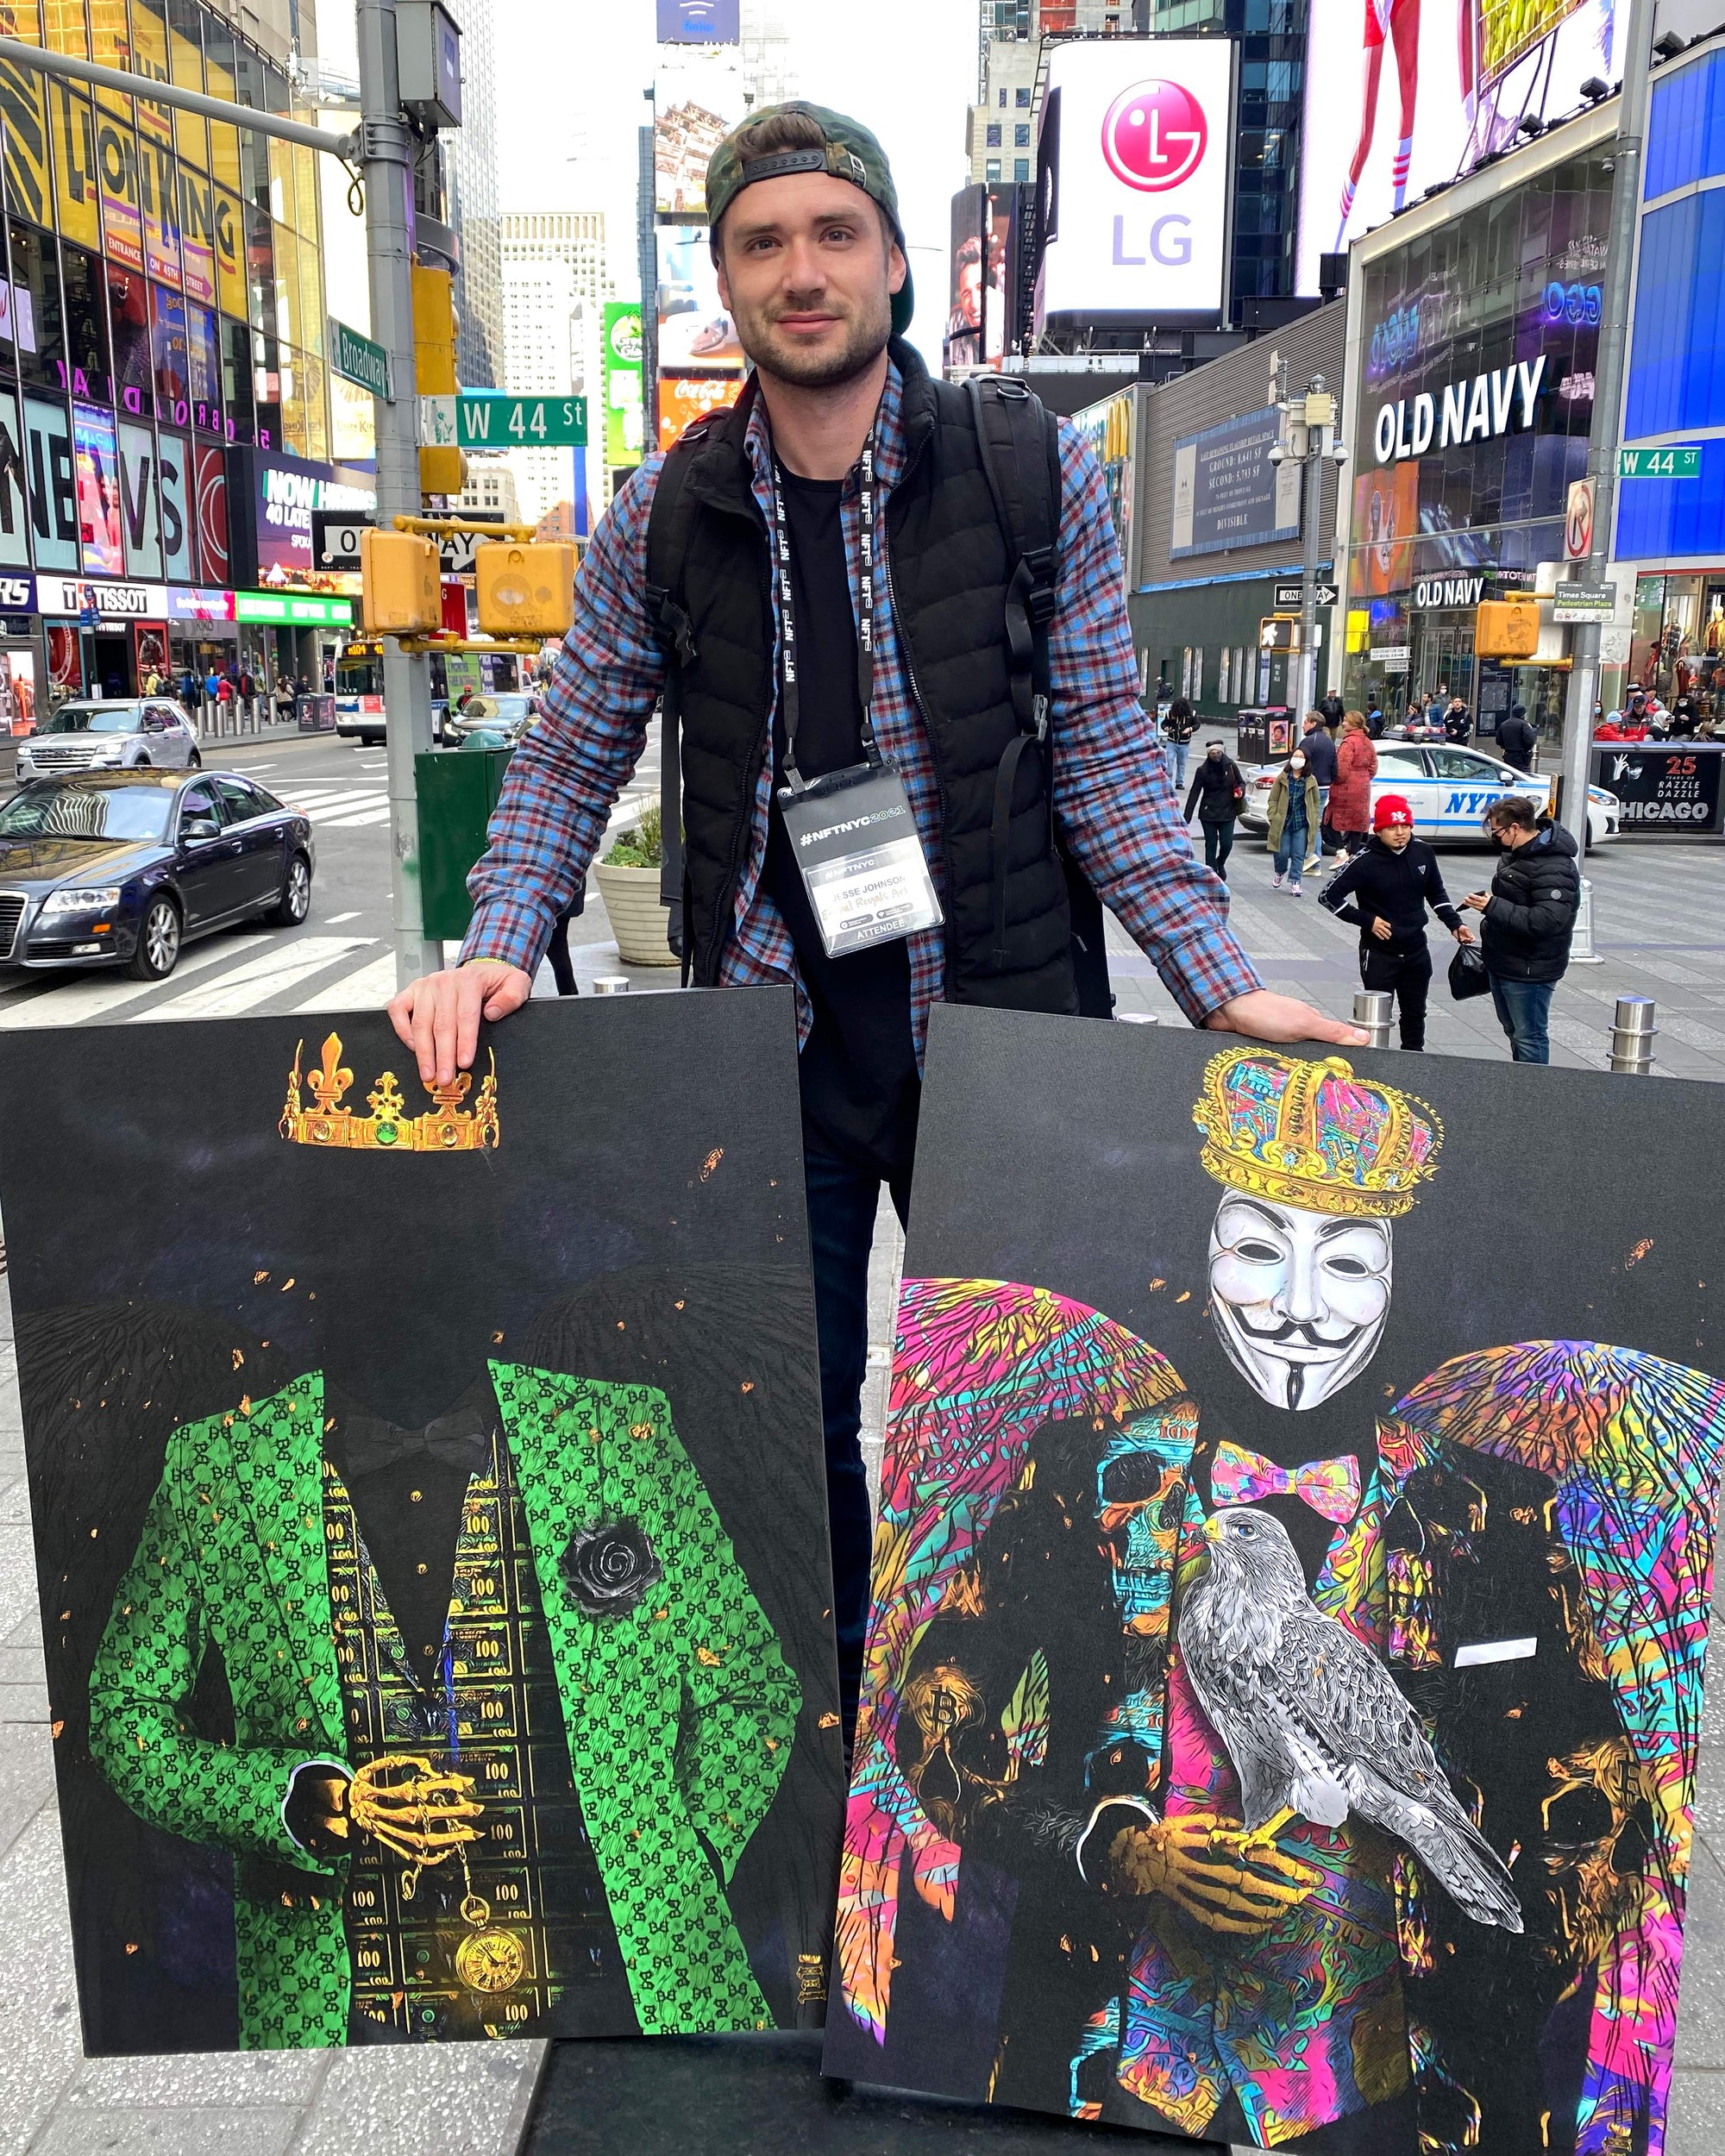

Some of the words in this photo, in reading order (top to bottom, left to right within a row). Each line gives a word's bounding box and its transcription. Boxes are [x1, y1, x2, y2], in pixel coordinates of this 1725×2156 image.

[60, 73, 154, 214] LION
[155, 131, 236, 260] KING
[1112, 214, 1193, 266] LG
[108, 236, 141, 262] ENTRANCE
[149, 257, 161, 273] ON
[163, 264, 179, 280] 45TH
[186, 276, 204, 293] STREET
[342, 332, 386, 398] Broadway
[1375, 392, 1435, 463] OLD
[1440, 354, 1547, 448] NAVY
[463, 402, 491, 439] W
[508, 403, 547, 439] 44
[562, 403, 583, 425] St
[1623, 452, 1640, 474] W
[1647, 453, 1674, 474] 44
[1684, 451, 1697, 465] ST
[267, 468, 317, 510] NOW
[1208, 473, 1234, 490] SECOND:
[266, 503, 283, 525] 40
[284, 505, 311, 530] LATE
[1217, 513, 1248, 530] DIVISIBLE
[95, 586, 147, 613] TISSOT
[1285, 592, 1302, 600] ONE
[1417, 581, 1443, 607] OLD
[1445, 577, 1484, 605] NAVY
[1558, 591, 1579, 599] Times
[1580, 592, 1606, 600] Square
[196, 620, 214, 631] KIKO
[1665, 755, 1697, 775] 25
[1657, 790, 1700, 799] DAZZLE
[1620, 801, 1709, 820] HICAGO
[799, 805, 906, 848] #NFTNYC2021
[832, 887, 861, 903] JESSE
[862, 874, 906, 893] JOHNSON
[856, 918, 906, 940] ATTENDEE
[466, 1517, 490, 1534] 100
[471, 1578, 494, 1595] 100
[475, 1640, 499, 1658] 100
[480, 1702, 504, 1719] 100
[485, 1763, 509, 1780] 100
[490, 1824, 513, 1840] 100
[352, 1890, 375, 1907] 100
[495, 1884, 518, 1901] 100
[357, 1951, 380, 1967] 100
[505, 2004, 529, 2021] 100
